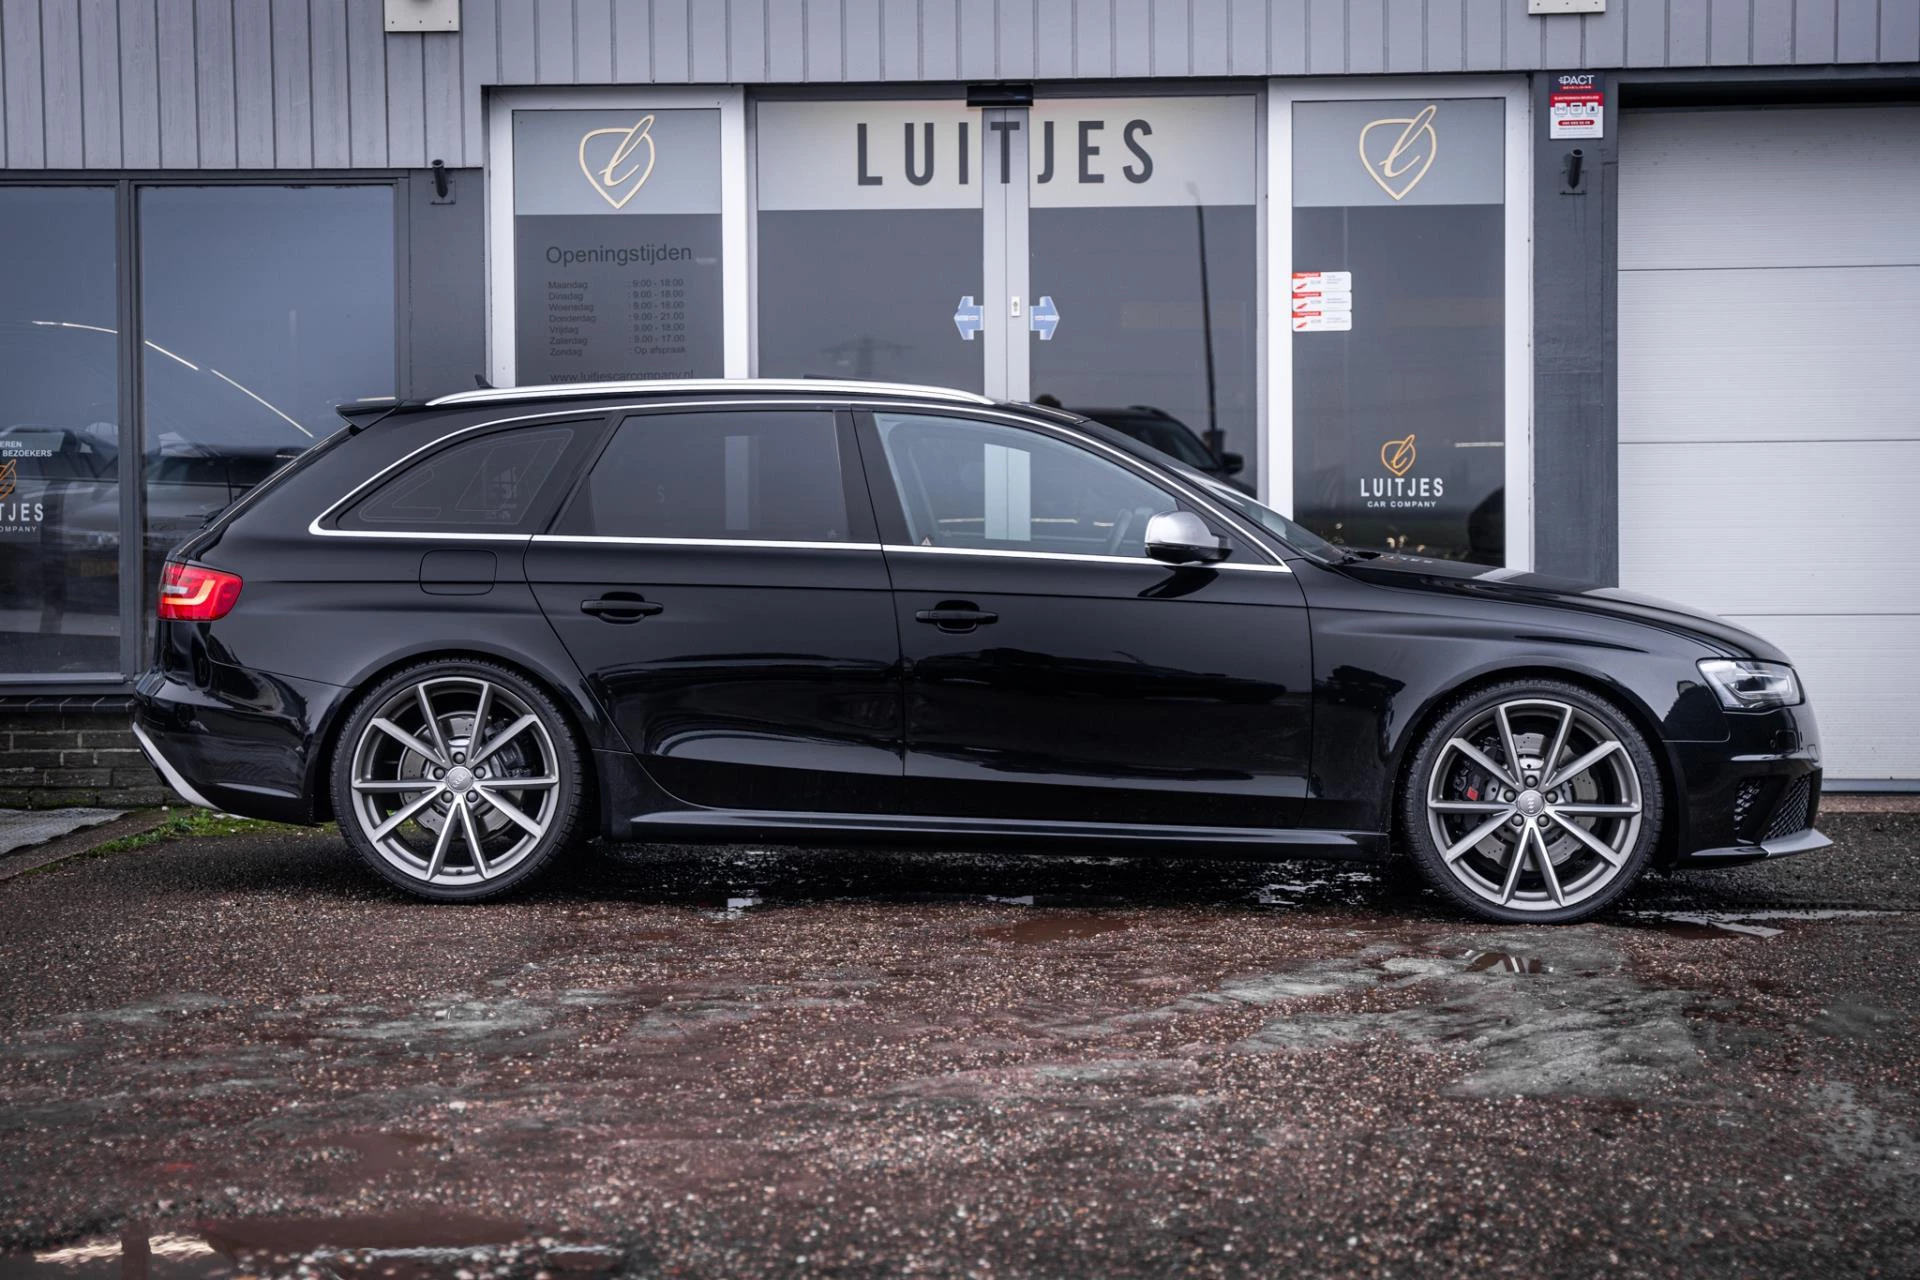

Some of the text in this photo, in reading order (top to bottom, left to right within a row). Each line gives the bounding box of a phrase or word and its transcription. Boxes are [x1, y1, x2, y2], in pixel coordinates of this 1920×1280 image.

[857, 119, 1153, 186] LUITJES
[546, 243, 692, 267] Openingstijden
[548, 281, 588, 290] Maandag
[548, 291, 584, 301] Dinsdag
[633, 346, 647, 355] Op
[2, 449, 53, 457] BEZOEKERS
[1360, 477, 1444, 497] LUITJES
[1390, 500, 1437, 508] COMPANY
